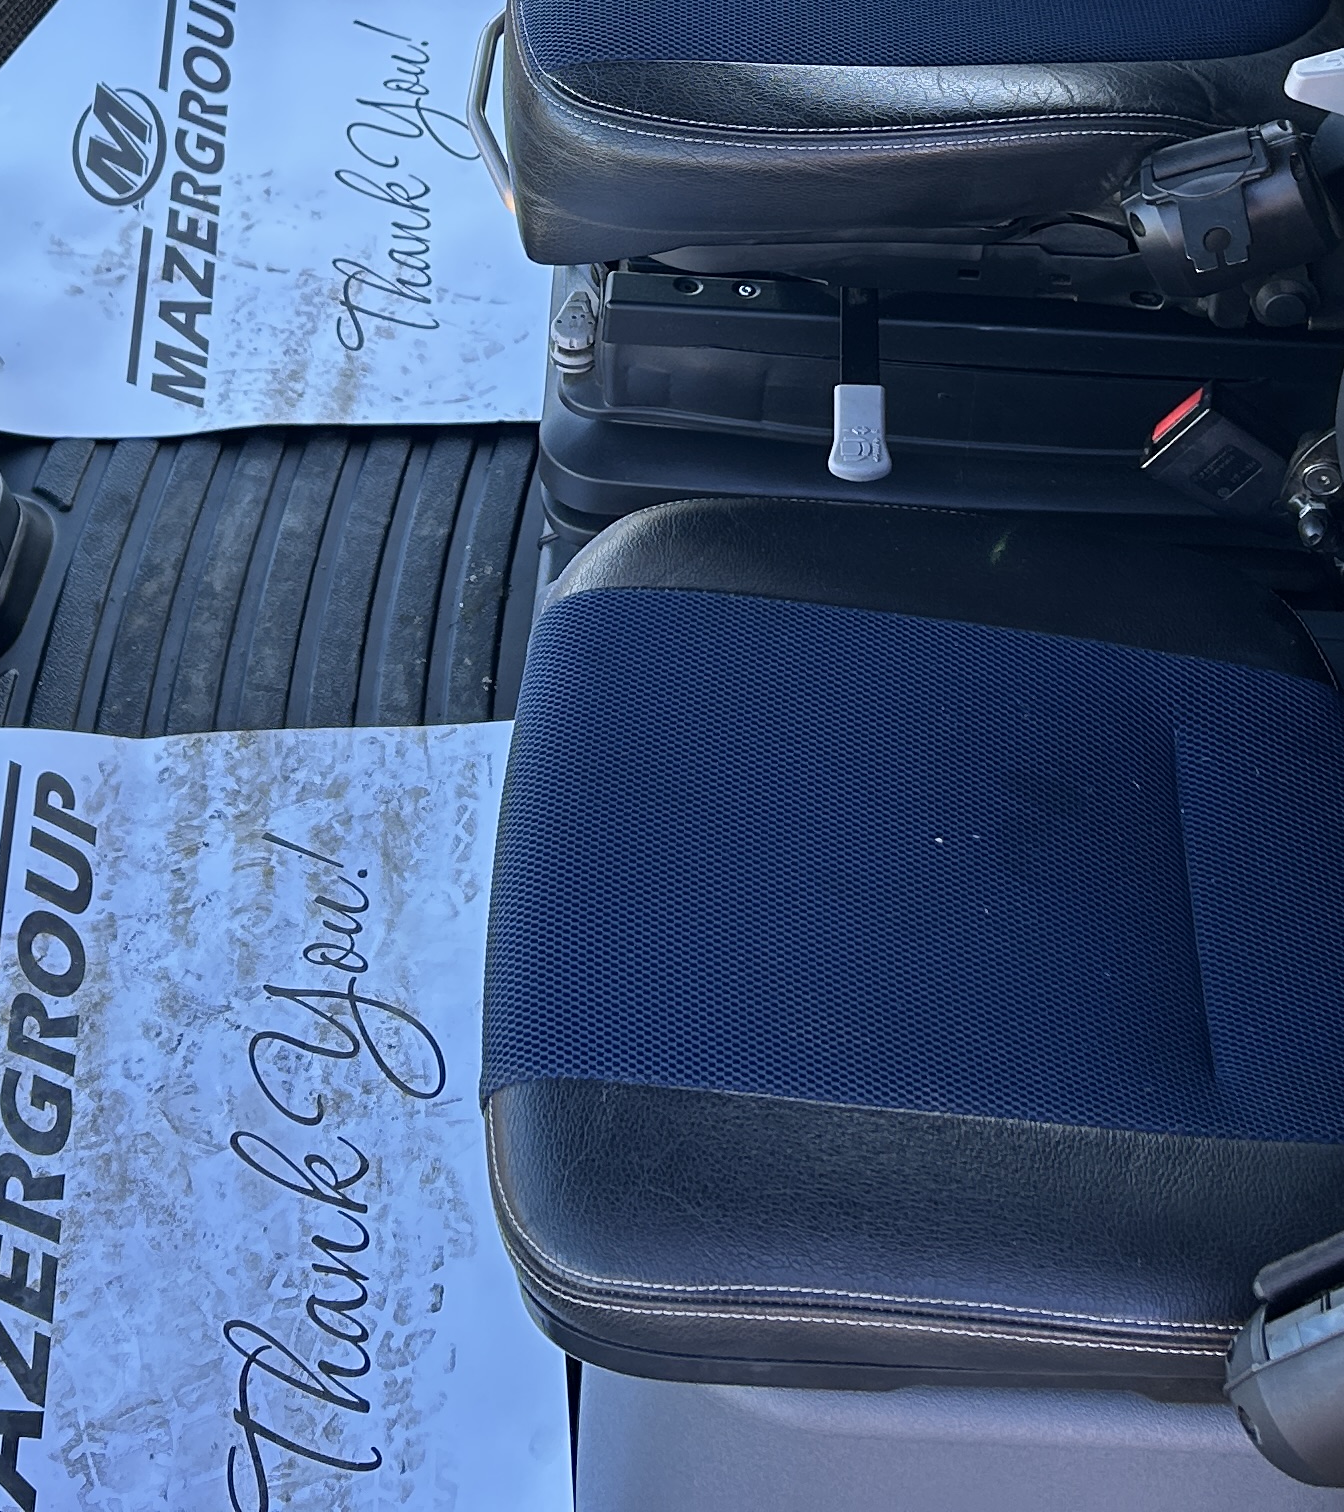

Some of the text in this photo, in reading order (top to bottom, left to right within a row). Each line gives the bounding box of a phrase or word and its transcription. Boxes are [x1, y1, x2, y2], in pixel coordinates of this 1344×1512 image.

[332, 19, 483, 352] Thank You!
[224, 832, 446, 1512] Thank You!
